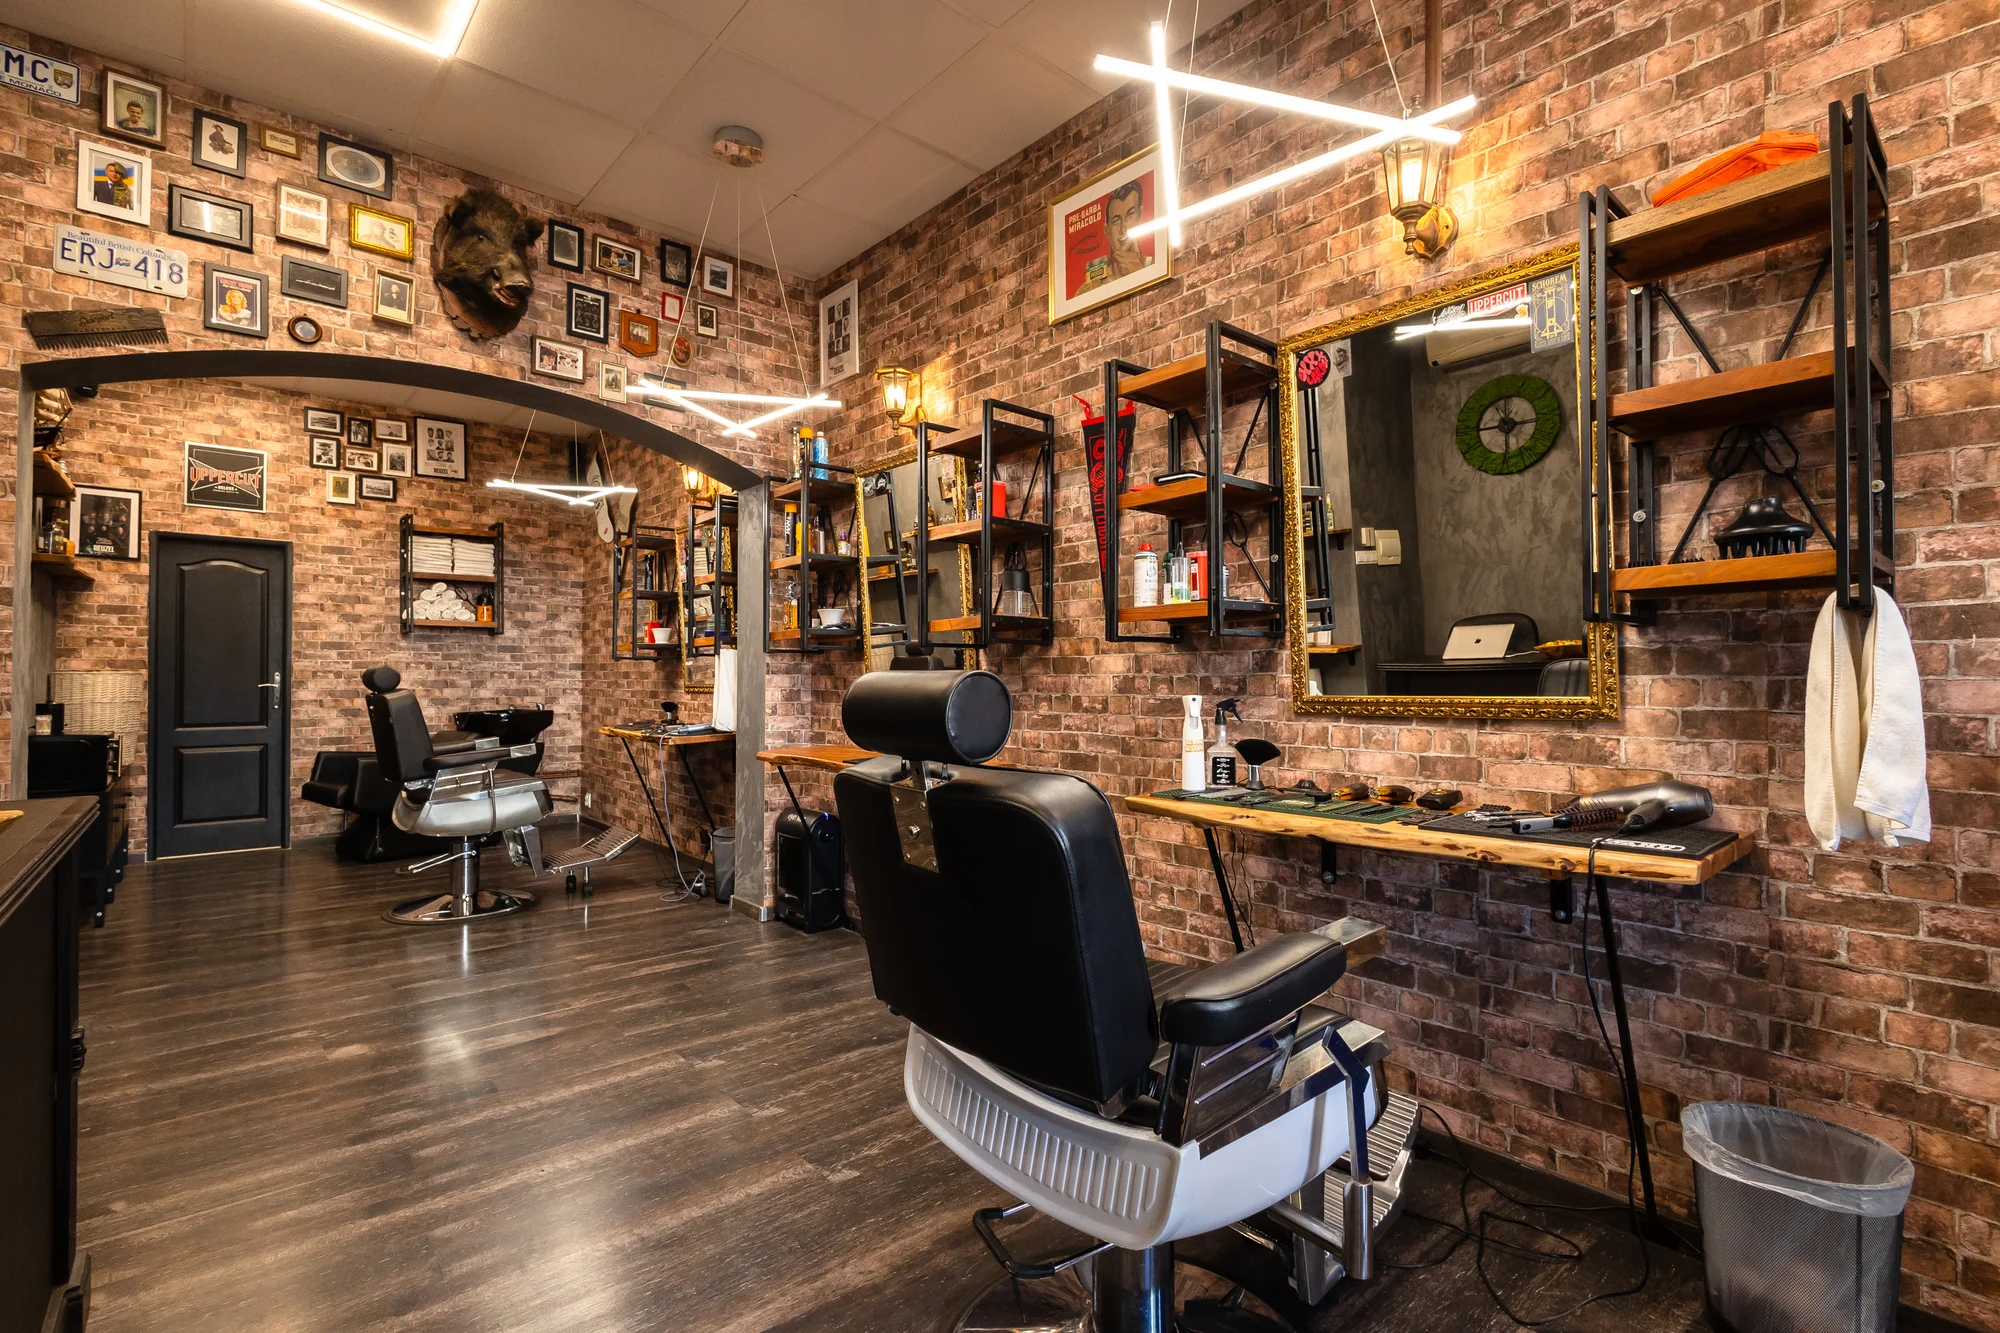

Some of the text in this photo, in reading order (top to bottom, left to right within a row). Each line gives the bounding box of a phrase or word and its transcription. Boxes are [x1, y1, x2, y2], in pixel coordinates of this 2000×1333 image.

[4, 50, 49, 83] MC
[9, 78, 62, 97] MONACO
[1068, 202, 1102, 226] PRE-BARBA
[1068, 211, 1102, 234] MIRACOLO
[67, 231, 176, 262] Beautiful British Columbia
[60, 237, 184, 285] ERJ 418
[1531, 273, 1568, 293] SCHOREM
[1469, 286, 1523, 315] UPPERCUT
[189, 467, 262, 489] UPPERCUT
